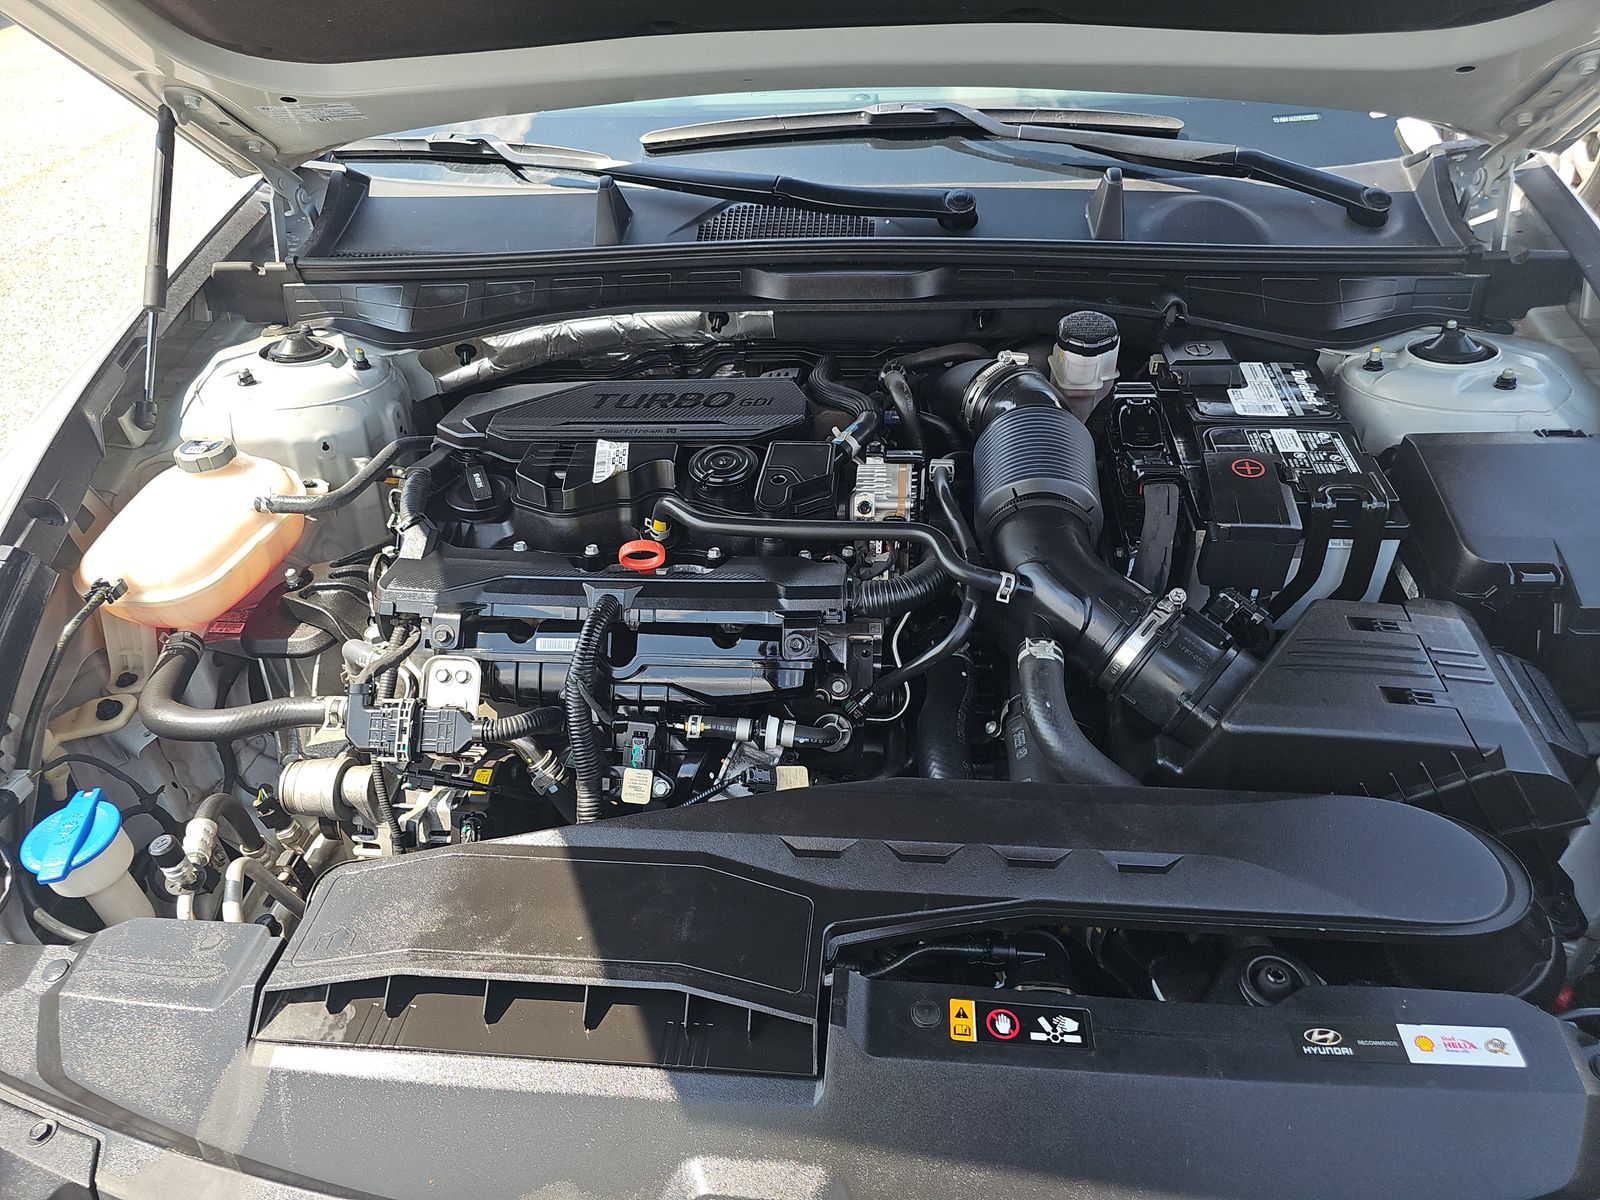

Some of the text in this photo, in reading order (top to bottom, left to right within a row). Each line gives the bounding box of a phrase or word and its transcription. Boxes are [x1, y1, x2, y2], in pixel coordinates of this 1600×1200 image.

[1291, 369, 1323, 407] Duralast
[593, 392, 736, 409] TURBO
[1302, 1039, 1399, 1056] HYUNDAI RECOMMENDS
[1442, 1041, 1479, 1050] HELIX
